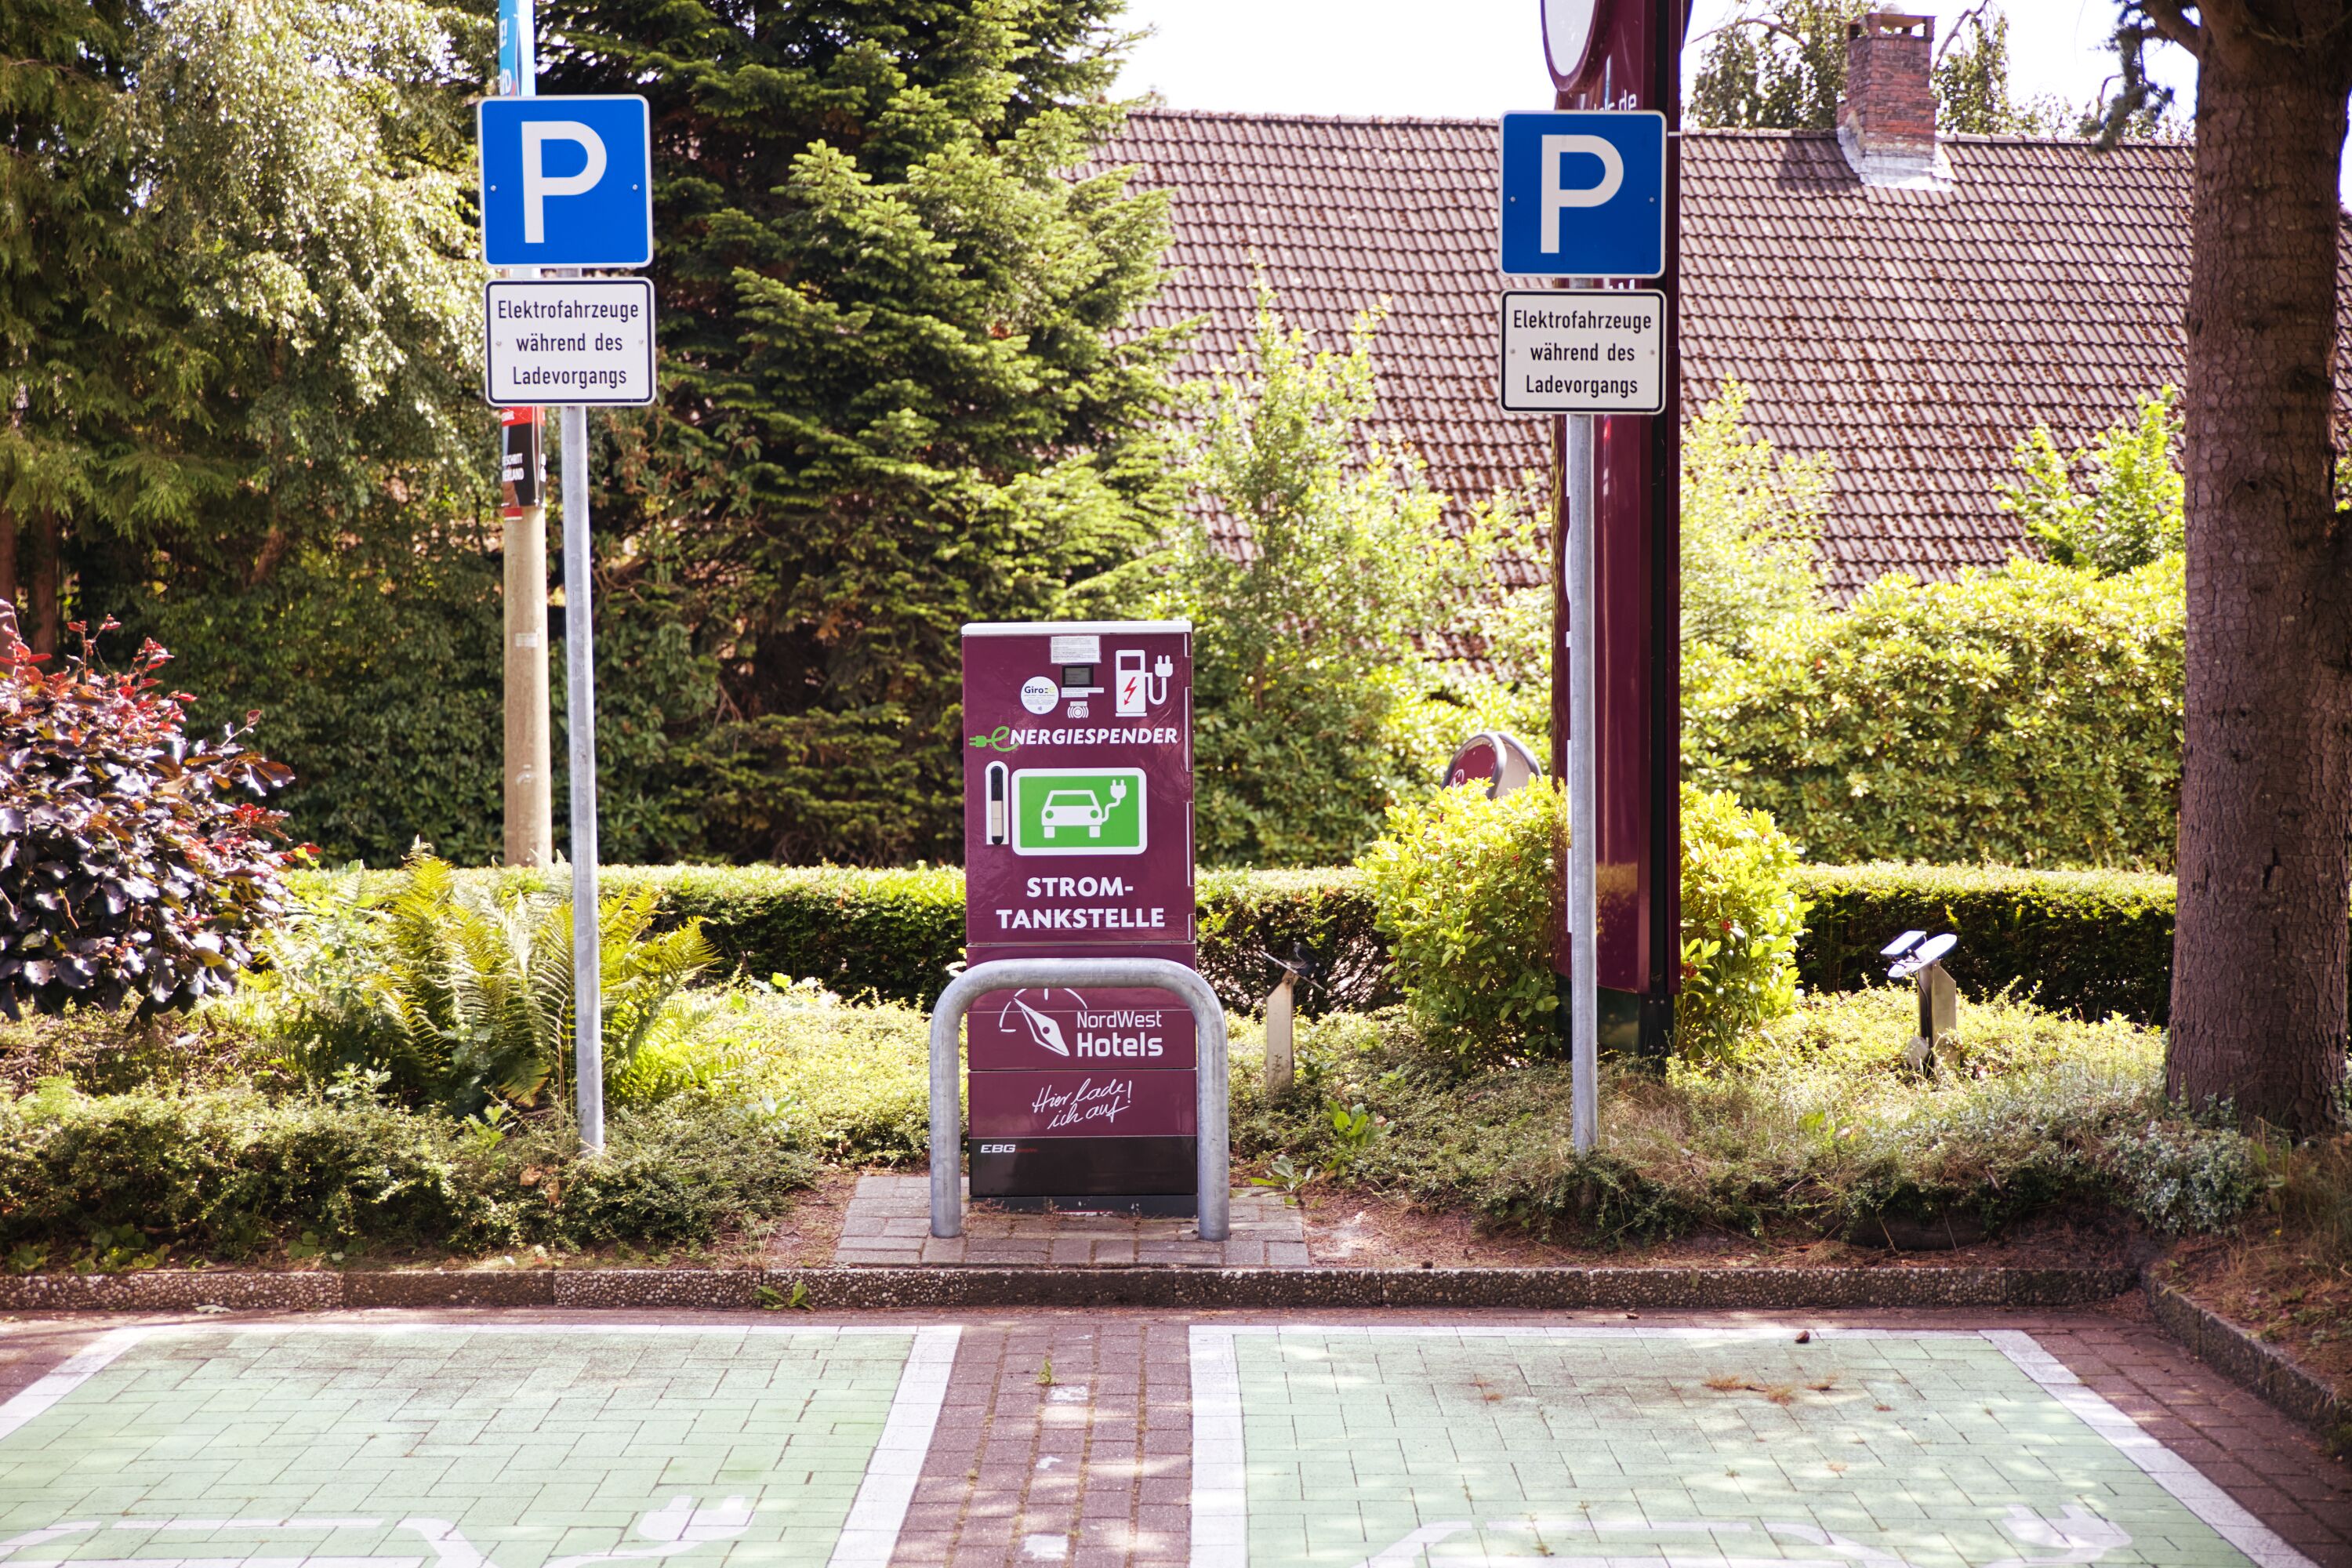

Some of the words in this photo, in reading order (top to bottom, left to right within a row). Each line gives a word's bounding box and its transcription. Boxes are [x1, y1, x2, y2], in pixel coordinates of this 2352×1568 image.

[521, 120, 608, 244] P
[1540, 134, 1624, 254] P
[498, 299, 639, 323] Elektrofahrzeuge
[1513, 310, 1652, 334] Elektrofahrzeuge
[516, 332, 586, 352] während
[595, 332, 623, 352] des
[1530, 342, 1599, 361] während
[1607, 342, 1635, 361] des
[513, 366, 627, 389] Ladevorgangs
[1526, 374, 1639, 398] Ladevorgangs
[1026, 877, 1134, 898] STROM-
[996, 907, 1166, 929] TANKSTELLE
[1076, 1011, 1163, 1029] NordWest
[1076, 1032, 1163, 1058] Hotels
[1032, 1084, 1073, 1113] Hier
[1047, 1103, 1083, 1129] ich
[980, 1144, 1016, 1153] EBG
